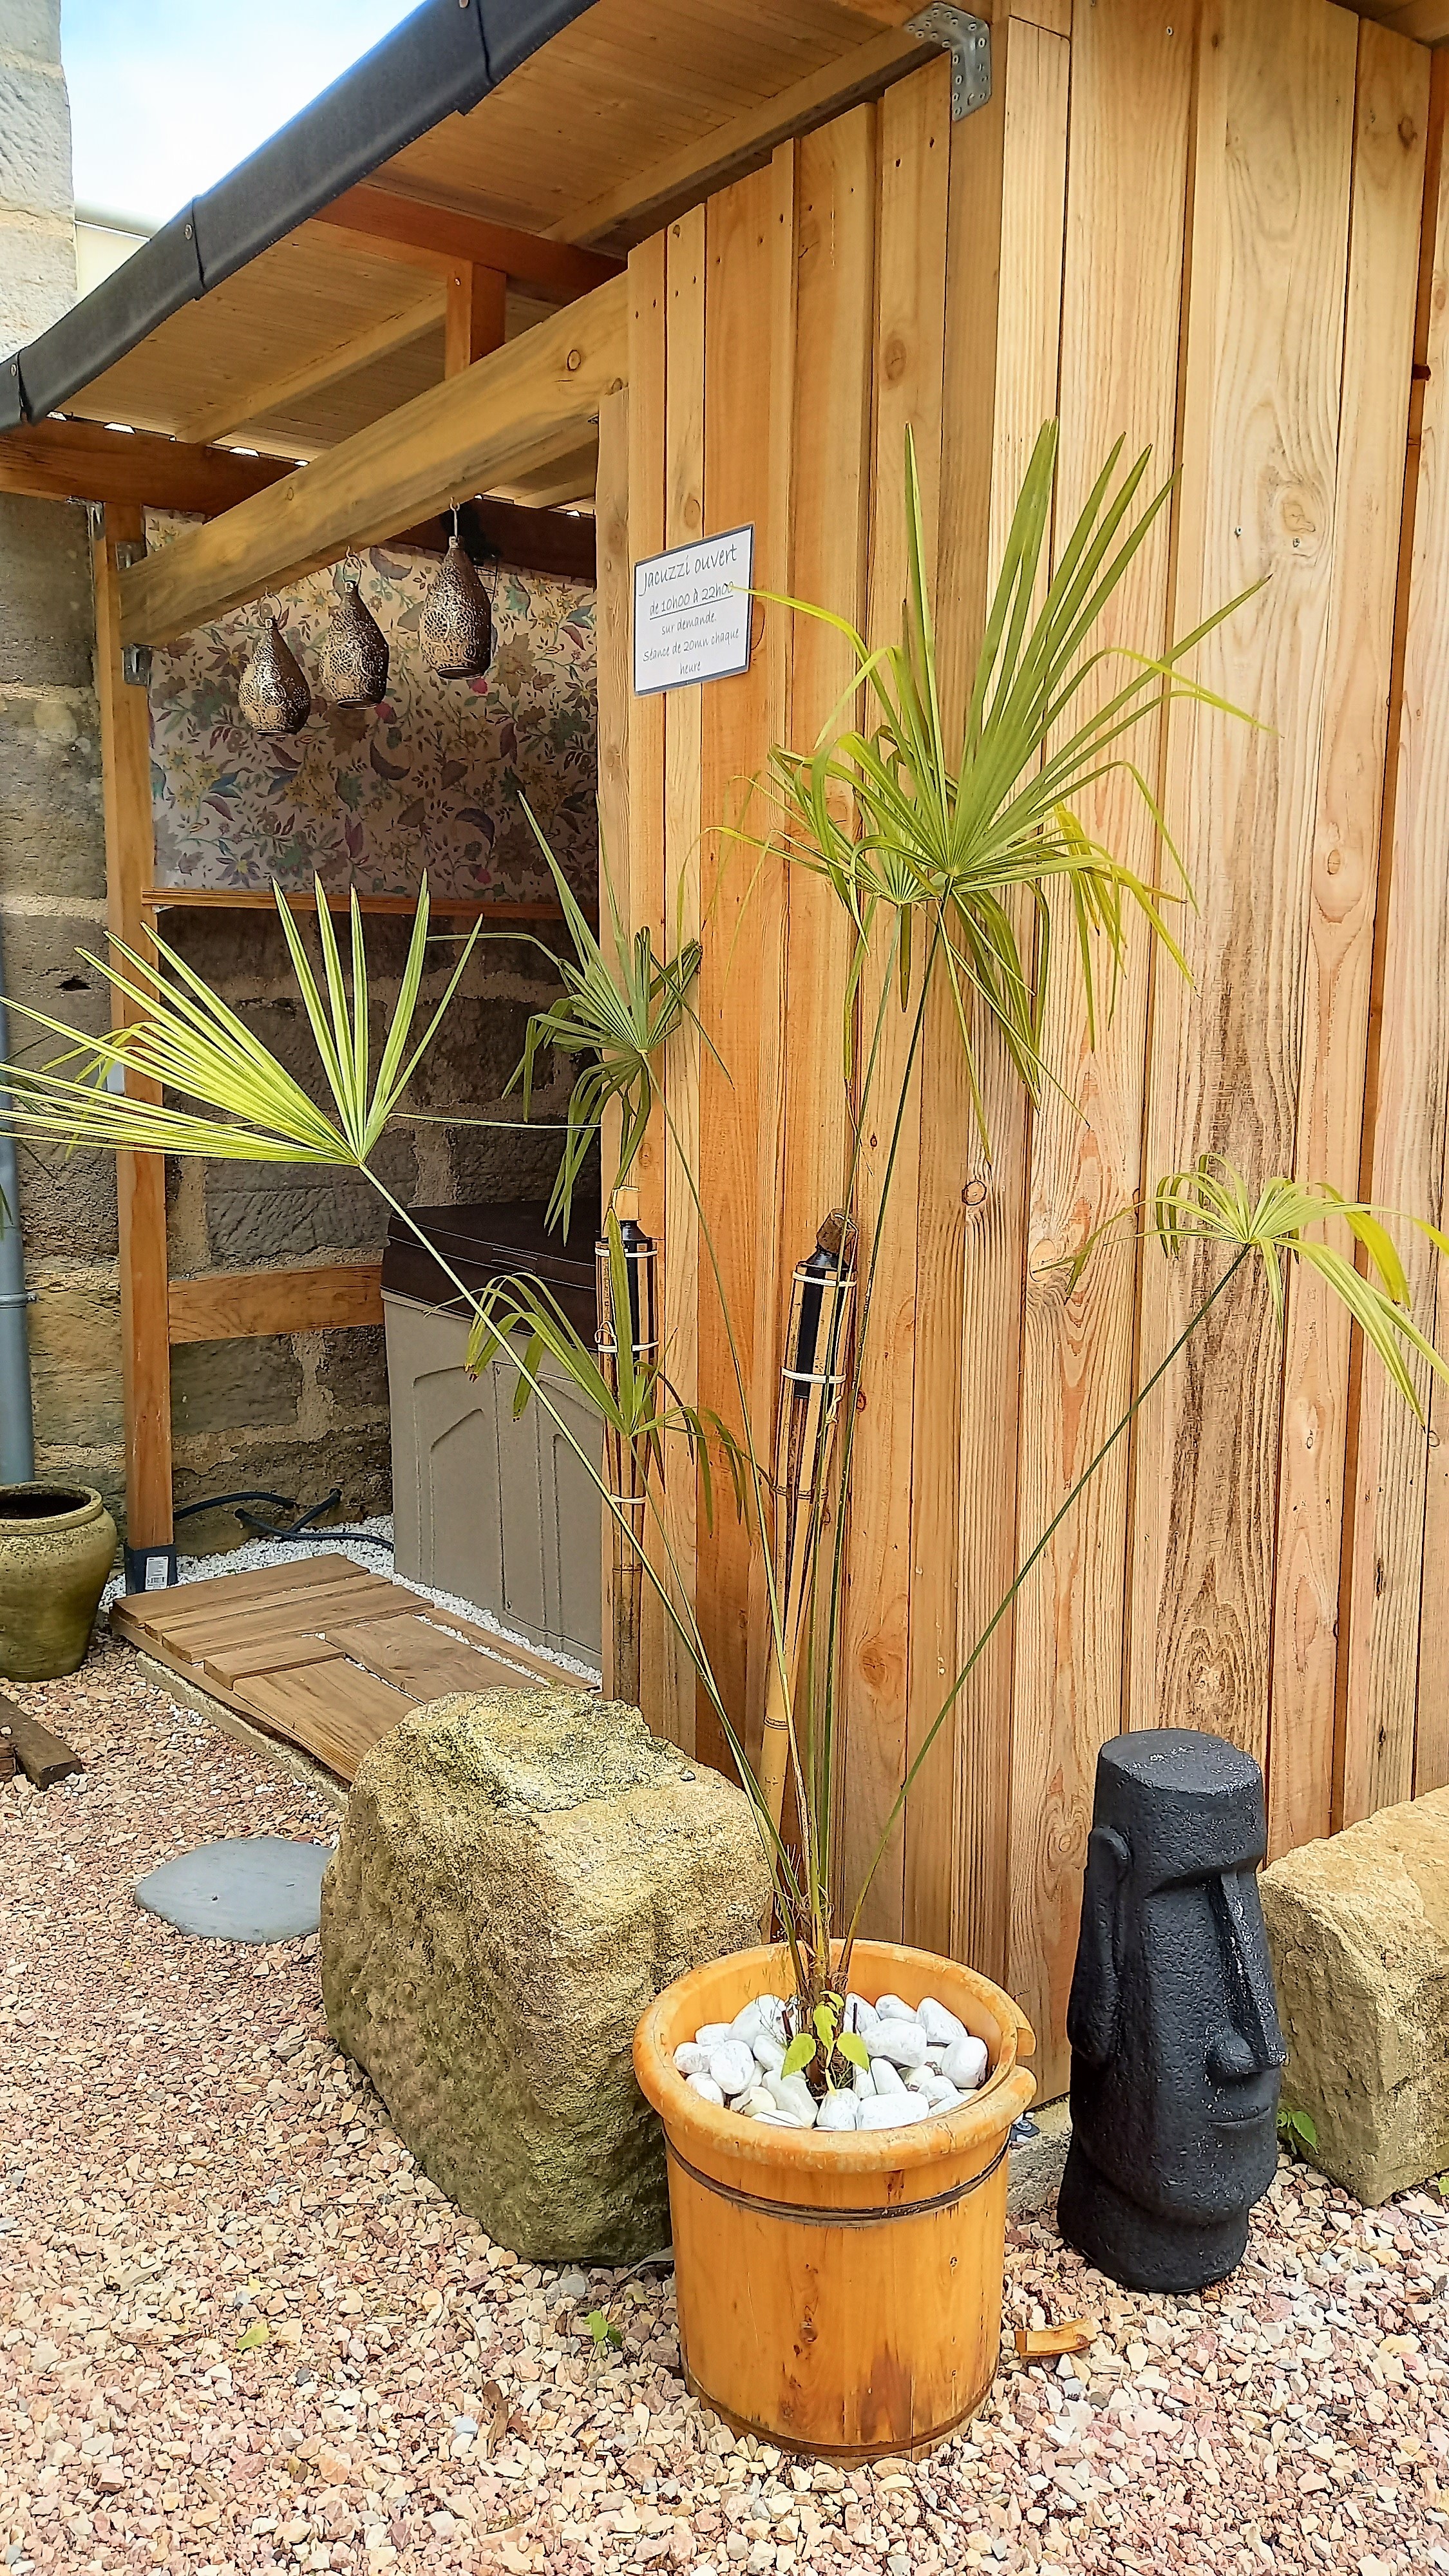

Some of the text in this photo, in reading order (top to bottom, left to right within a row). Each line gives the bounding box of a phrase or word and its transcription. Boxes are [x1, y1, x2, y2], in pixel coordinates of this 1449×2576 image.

[639, 544, 737, 596] Jacuzzi ouvert
[650, 600, 659, 616] de
[661, 592, 690, 612] 10h00
[701, 581, 734, 600] 22h00
[661, 624, 675, 636] sur
[672, 641, 681, 654] de
[711, 628, 739, 645] chaque
[680, 661, 701, 675] heure
